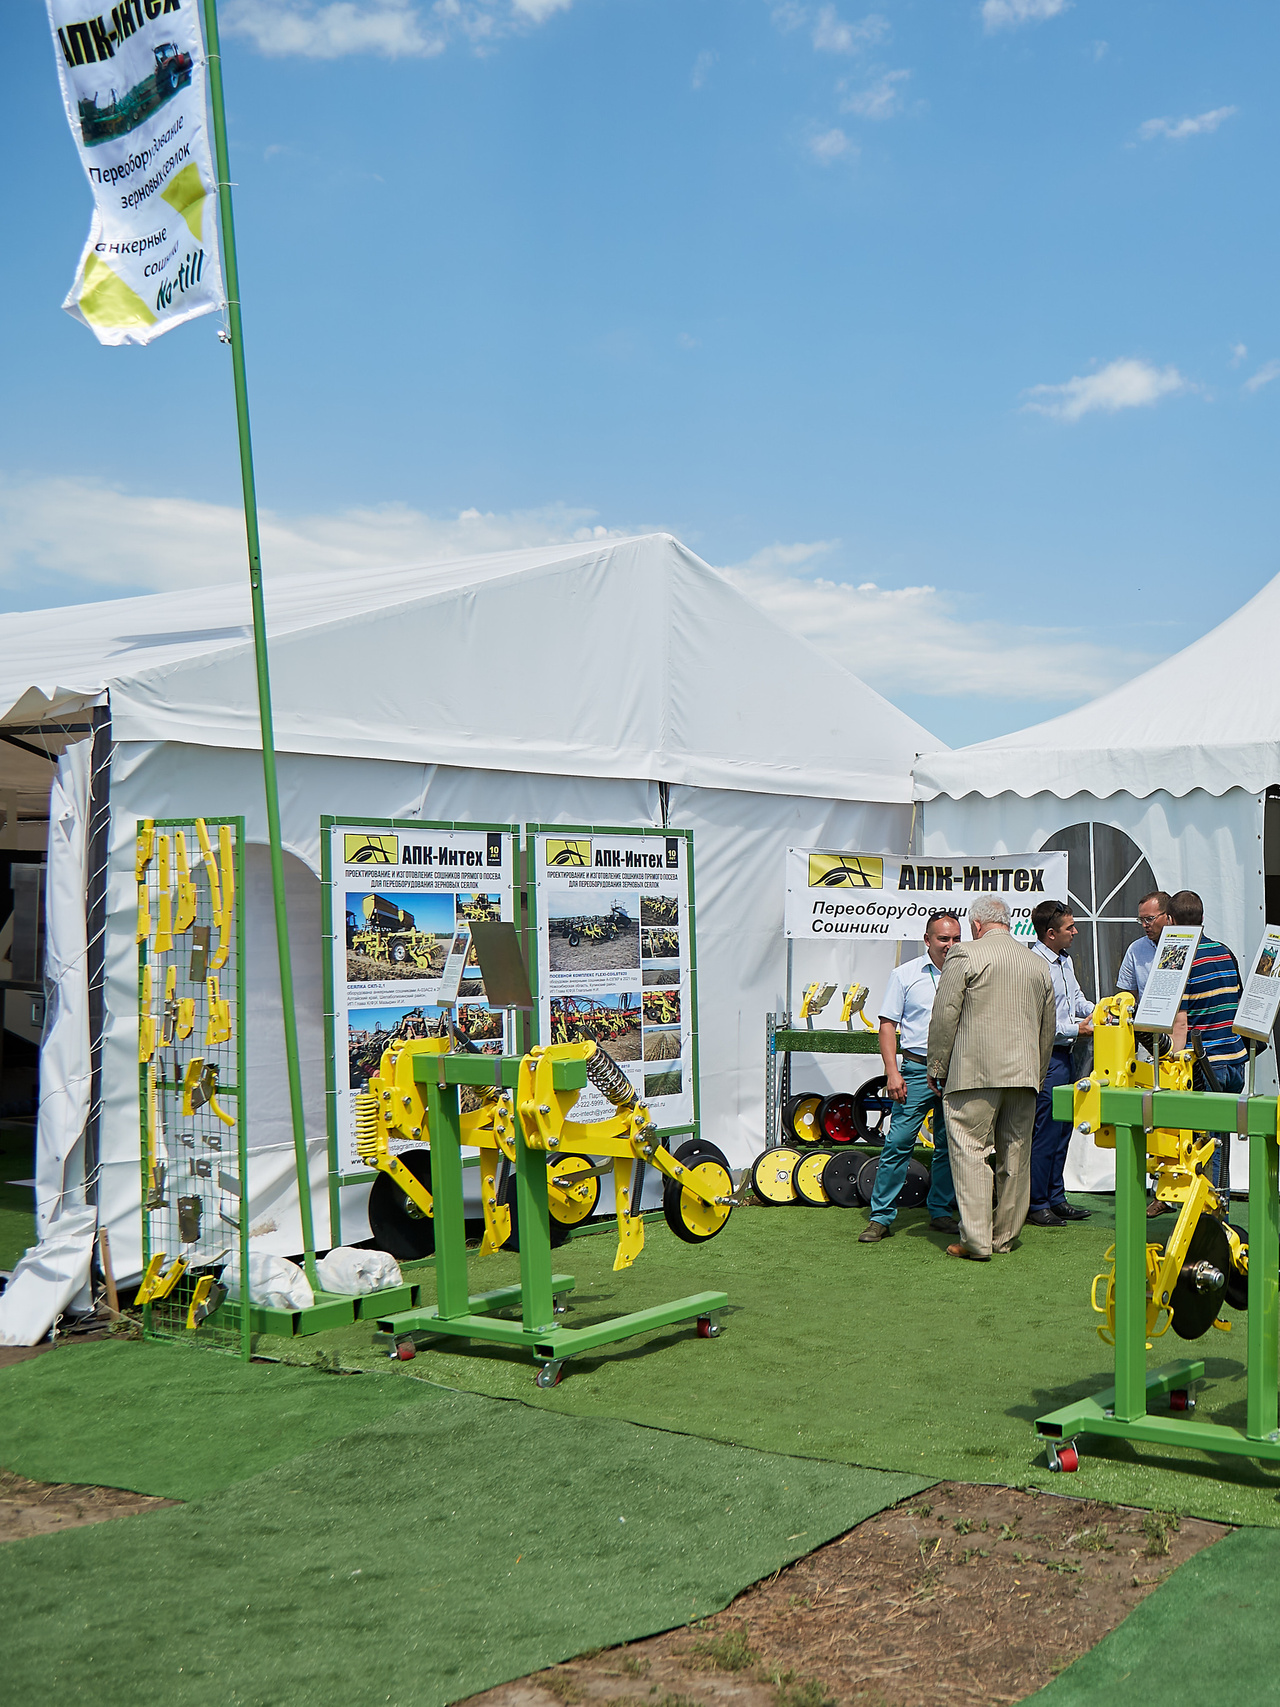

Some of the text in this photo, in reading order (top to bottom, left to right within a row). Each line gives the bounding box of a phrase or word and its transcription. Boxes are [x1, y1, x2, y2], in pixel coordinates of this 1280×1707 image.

[95, 228, 167, 256] анкерные
[157, 249, 204, 311] No-till
[402, 845, 483, 866] АПК-Интех
[489, 846, 499, 854] 10
[595, 849, 663, 868] АПК-Интех
[898, 864, 1045, 892] АПК-Интех
[812, 901, 967, 920] Переоборудовани
[812, 919, 889, 934] Сошники
